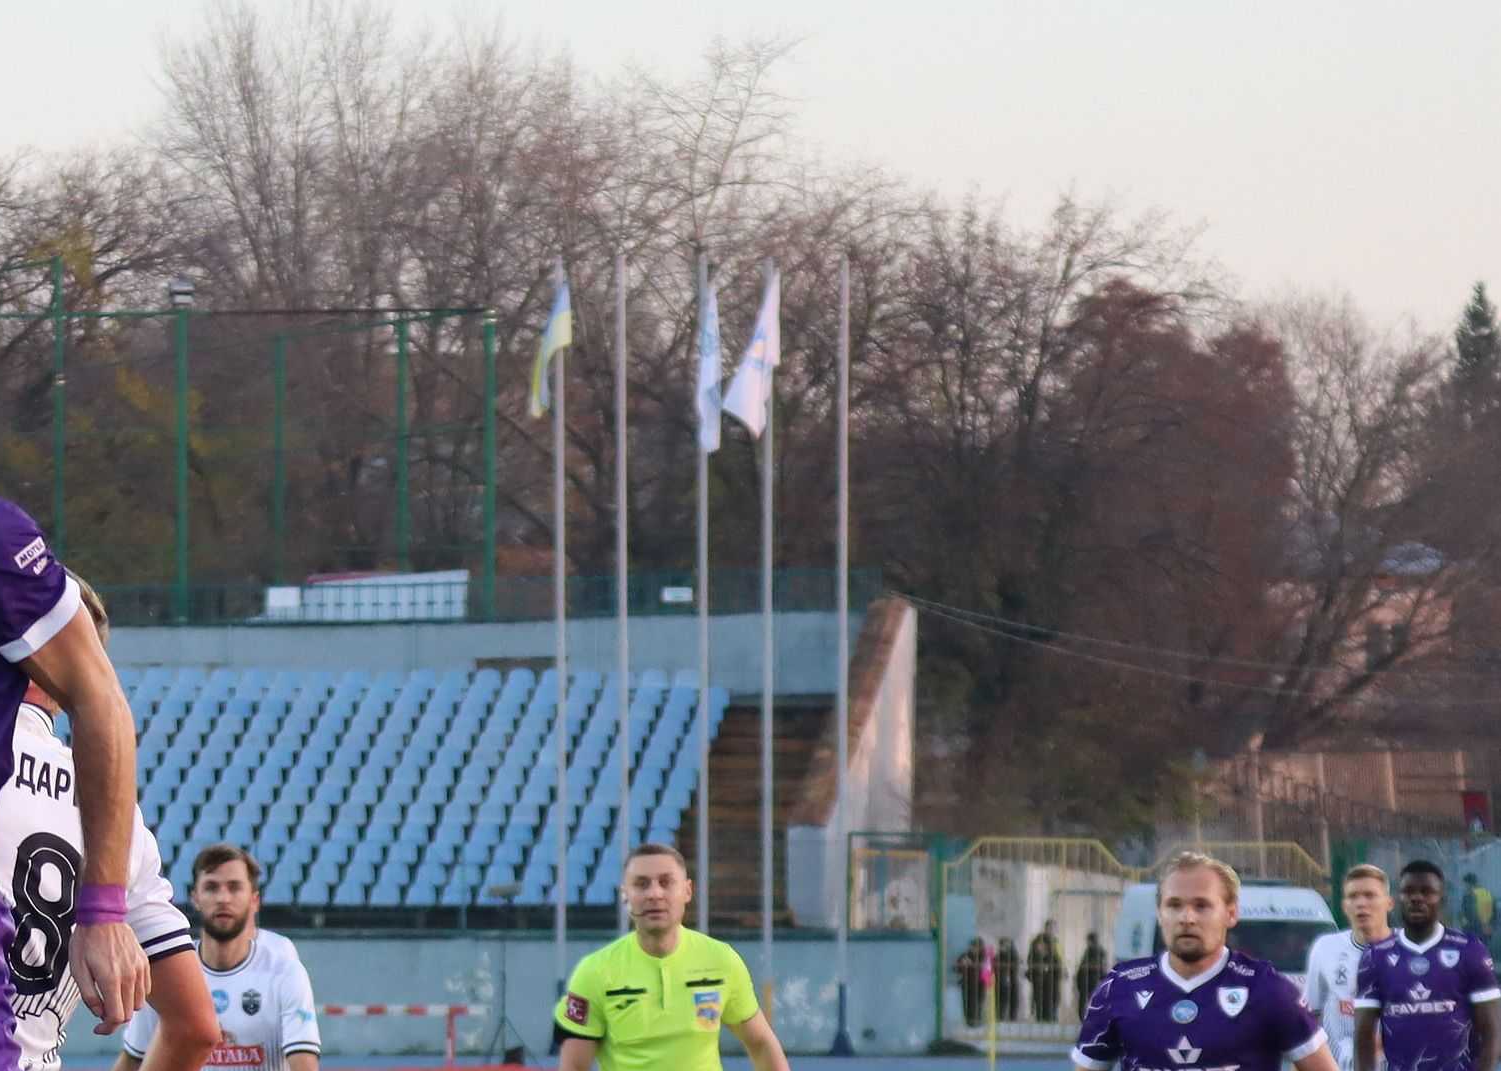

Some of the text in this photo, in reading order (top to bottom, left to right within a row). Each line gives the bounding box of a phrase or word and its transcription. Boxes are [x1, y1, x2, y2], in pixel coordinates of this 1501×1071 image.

[15, 752, 79, 807] ДАР
[9, 831, 84, 995] 8
[1389, 1000, 1456, 1016] FAVBET
